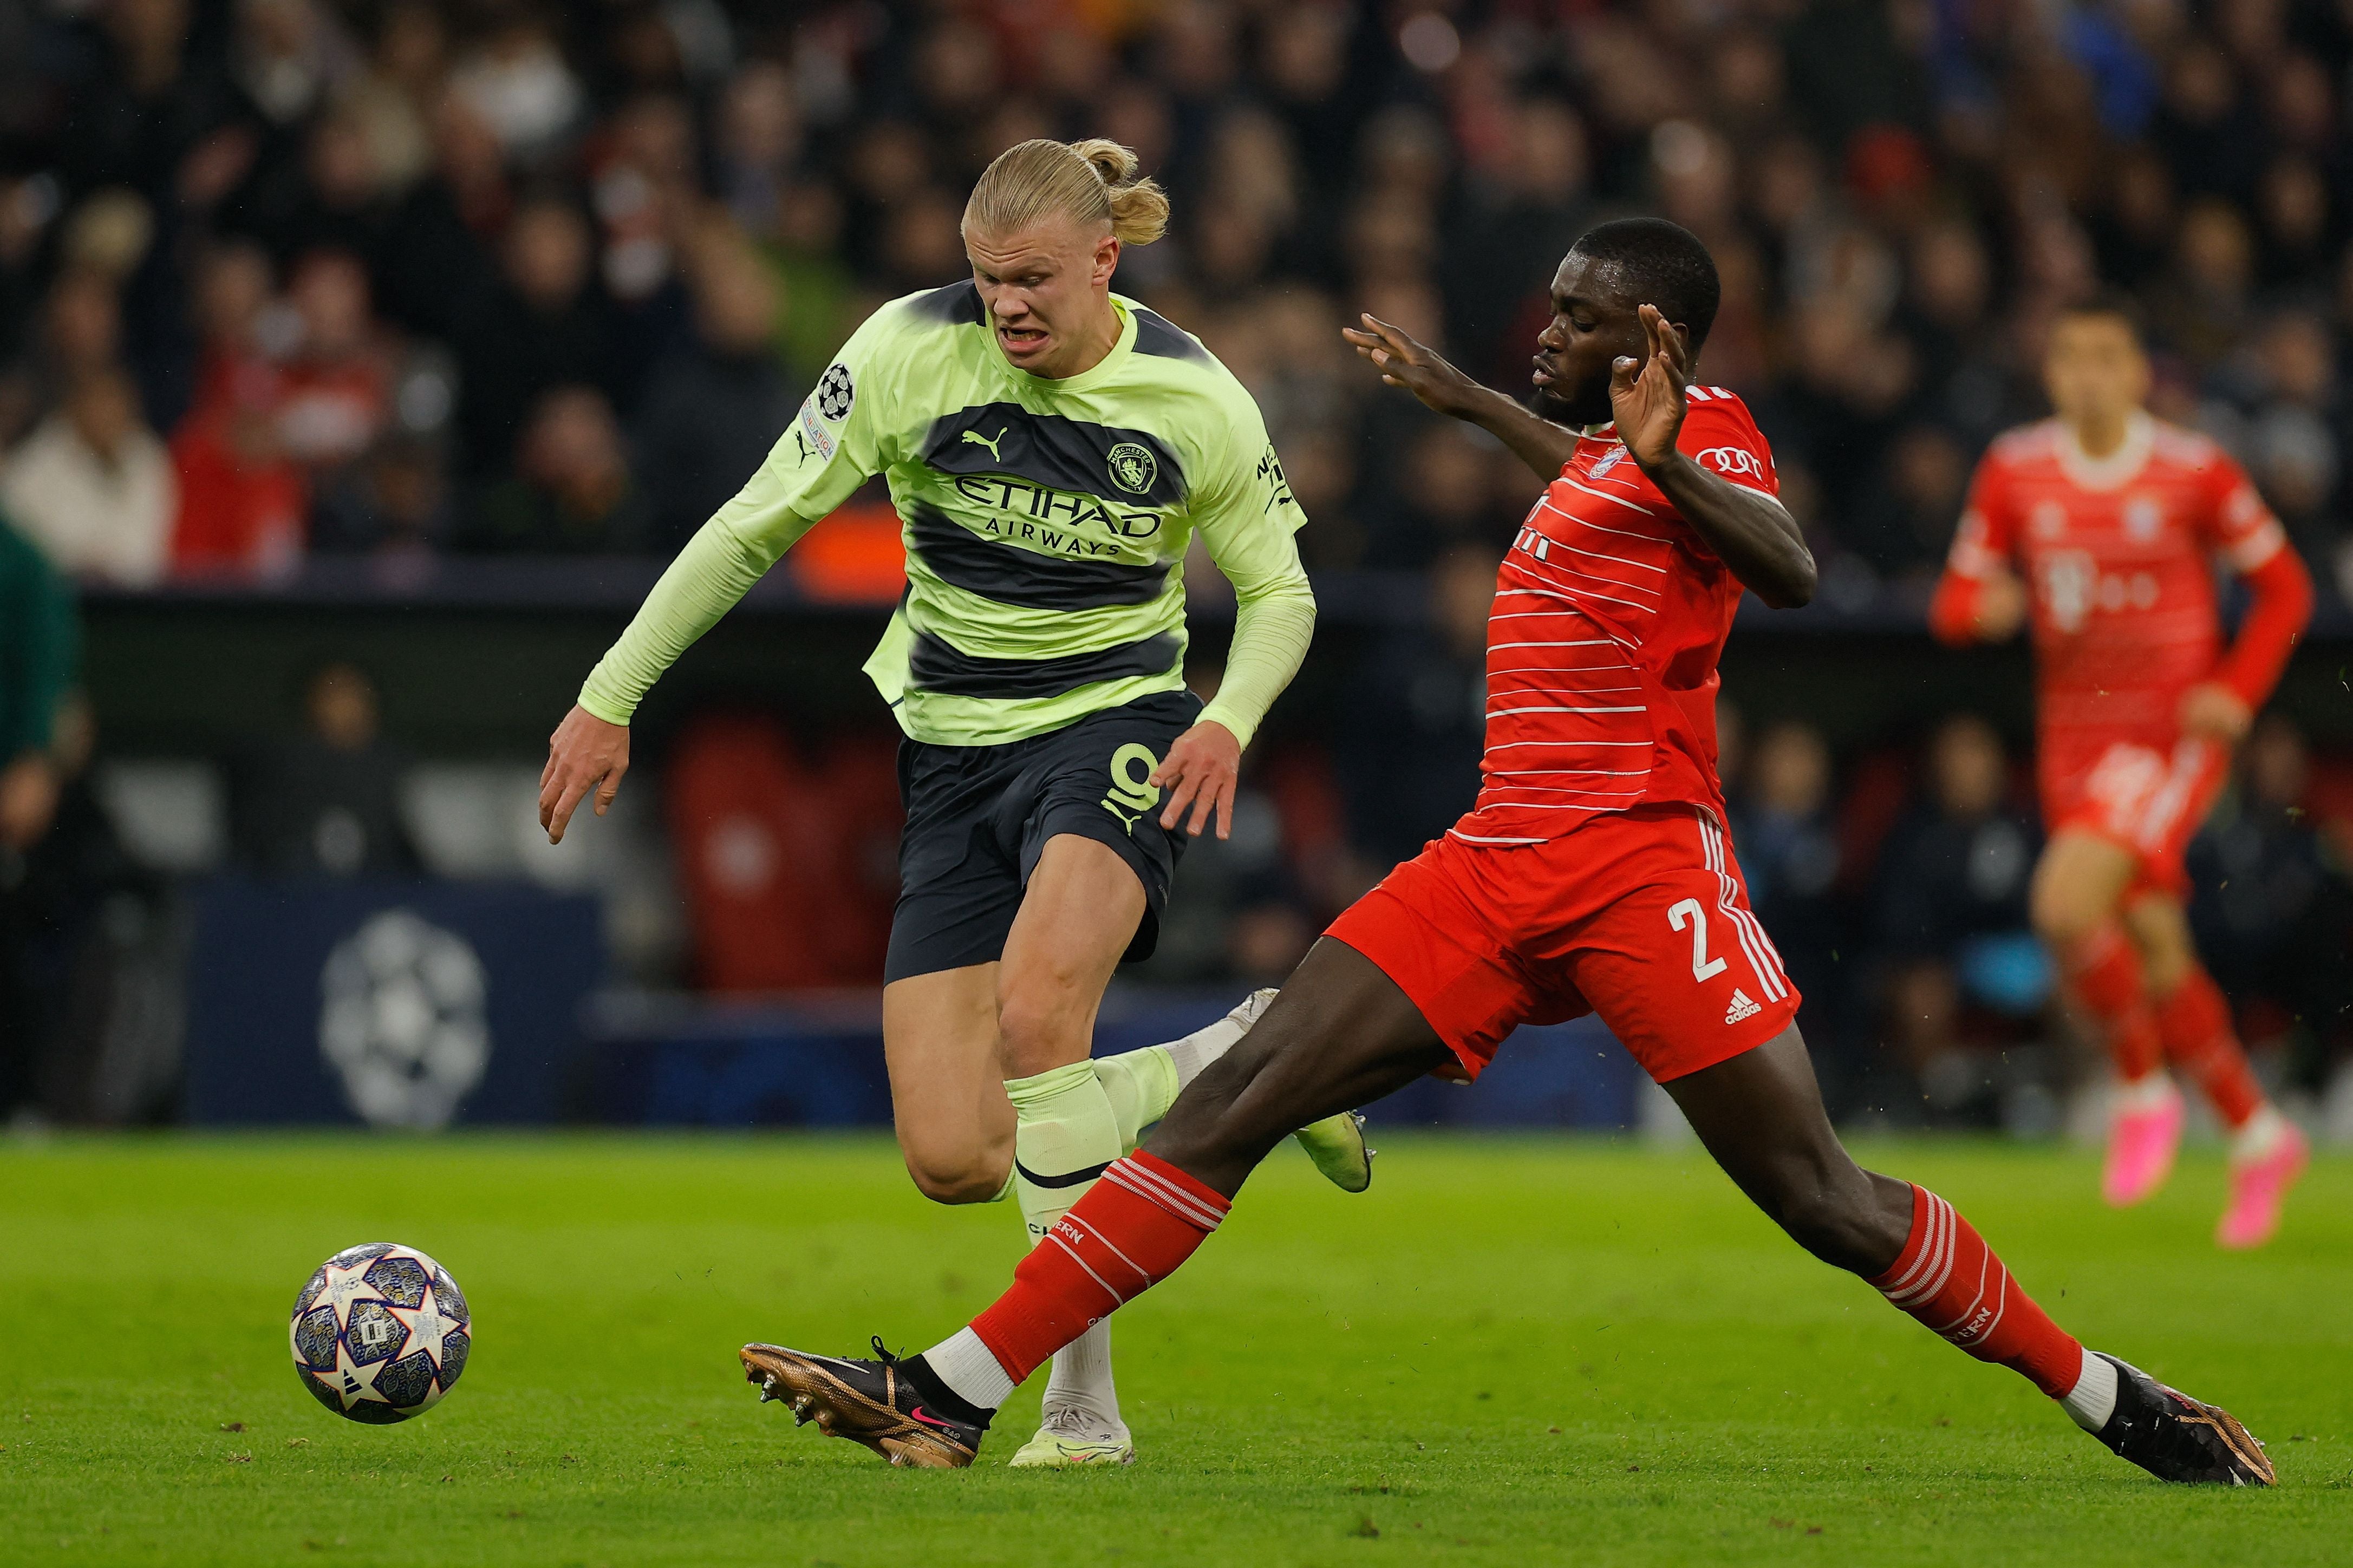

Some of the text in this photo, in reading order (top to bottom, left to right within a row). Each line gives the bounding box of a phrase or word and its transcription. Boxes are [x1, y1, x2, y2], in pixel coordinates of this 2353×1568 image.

[1110, 447, 1150, 464] MANCHESTER
[955, 475, 1161, 538] ETIHAD
[986, 518, 1120, 556] AIRWAYS
[1106, 743, 1160, 812] 9
[1667, 898, 1728, 983] 2
[1725, 1003, 1762, 1025] adidas
[1053, 1220, 1085, 1245] ERN
